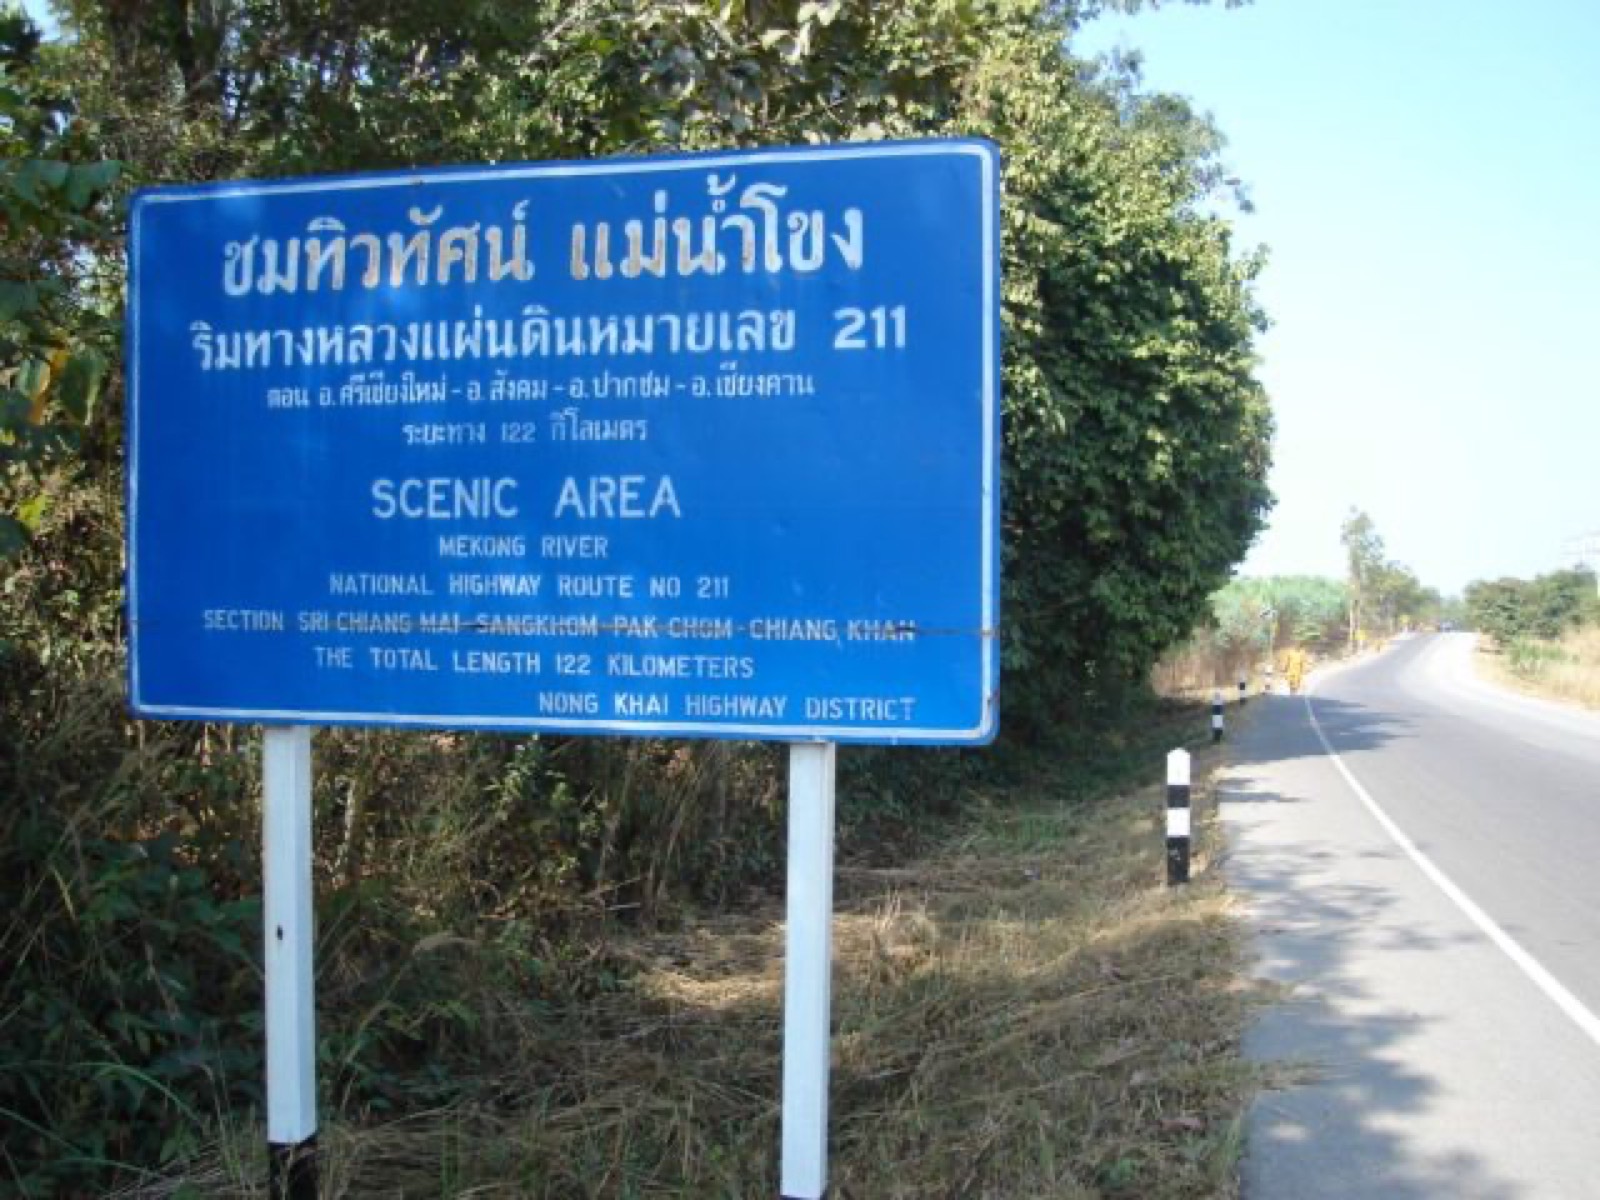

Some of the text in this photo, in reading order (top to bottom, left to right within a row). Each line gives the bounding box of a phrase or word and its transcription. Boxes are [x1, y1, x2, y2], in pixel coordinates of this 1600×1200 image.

[222, 173, 865, 298] ชมทิวทัศน์ แม่น้ำโขง
[190, 304, 908, 371] ริมทางหลวงแผ่นดินหมายเลข 211
[501, 421, 536, 443] 122
[371, 475, 682, 520] SCENIC AREA
[439, 535, 609, 559] MEKONG RIVER
[329, 573, 730, 600] NATIONAL HIGHWAY ROUTE NO 211
[203, 609, 284, 631] SECTION
[315, 647, 755, 680] THE TOTAL LENGTH 122 KILOMETERS
[538, 691, 917, 722] NONG KHAI HIGHWAY DISTRICT
